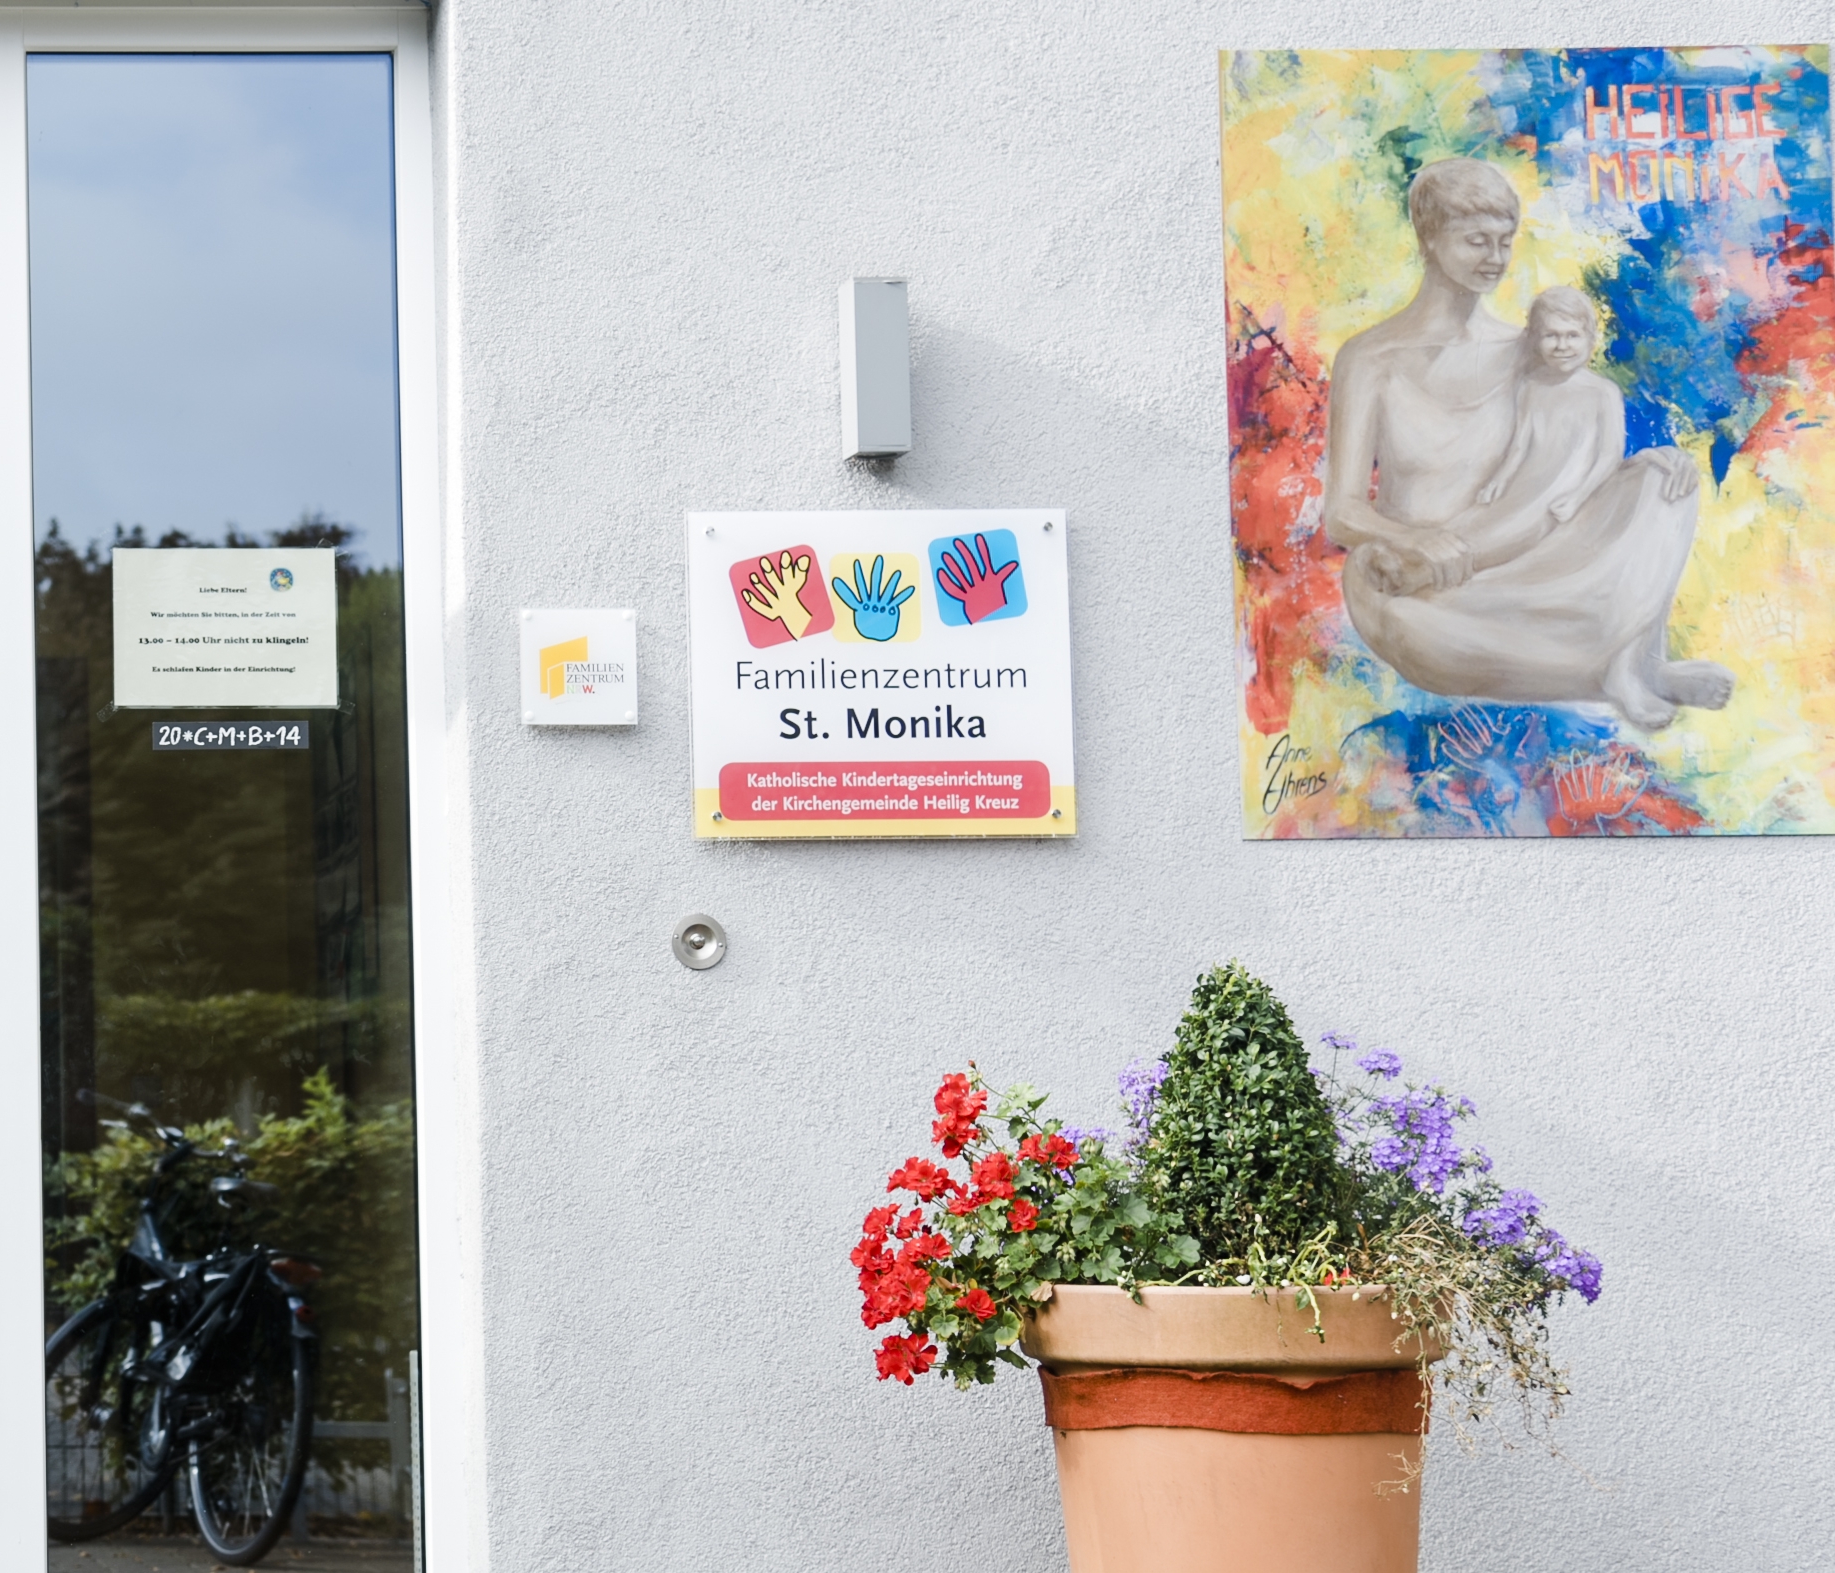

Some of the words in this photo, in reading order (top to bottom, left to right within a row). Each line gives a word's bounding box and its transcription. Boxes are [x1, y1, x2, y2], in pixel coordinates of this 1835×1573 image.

[214, 611, 240, 619] bitten,
[138, 637, 164, 645] 13.00
[175, 637, 200, 645] 14.00
[202, 636, 222, 645] Uhr
[224, 636, 250, 645] nicht
[251, 637, 264, 645] zu
[265, 636, 309, 646] klingeln!
[247, 666, 296, 674] Einrichtung!
[566, 663, 625, 673] FAMILIEN
[736, 657, 1027, 690] Familienzentrum
[566, 674, 625, 683] ZENTRUM
[779, 708, 830, 740] St.
[846, 704, 987, 739] Monika
[1265, 734, 1313, 770] Anne
[746, 770, 837, 788] Katholische
[842, 770, 1023, 791] Kindertageseinrichtung
[751, 795, 778, 812] der
[783, 794, 919, 815] Kirchengemeinde
[923, 793, 971, 814] Heilig
[975, 794, 1020, 811] Kreuz
